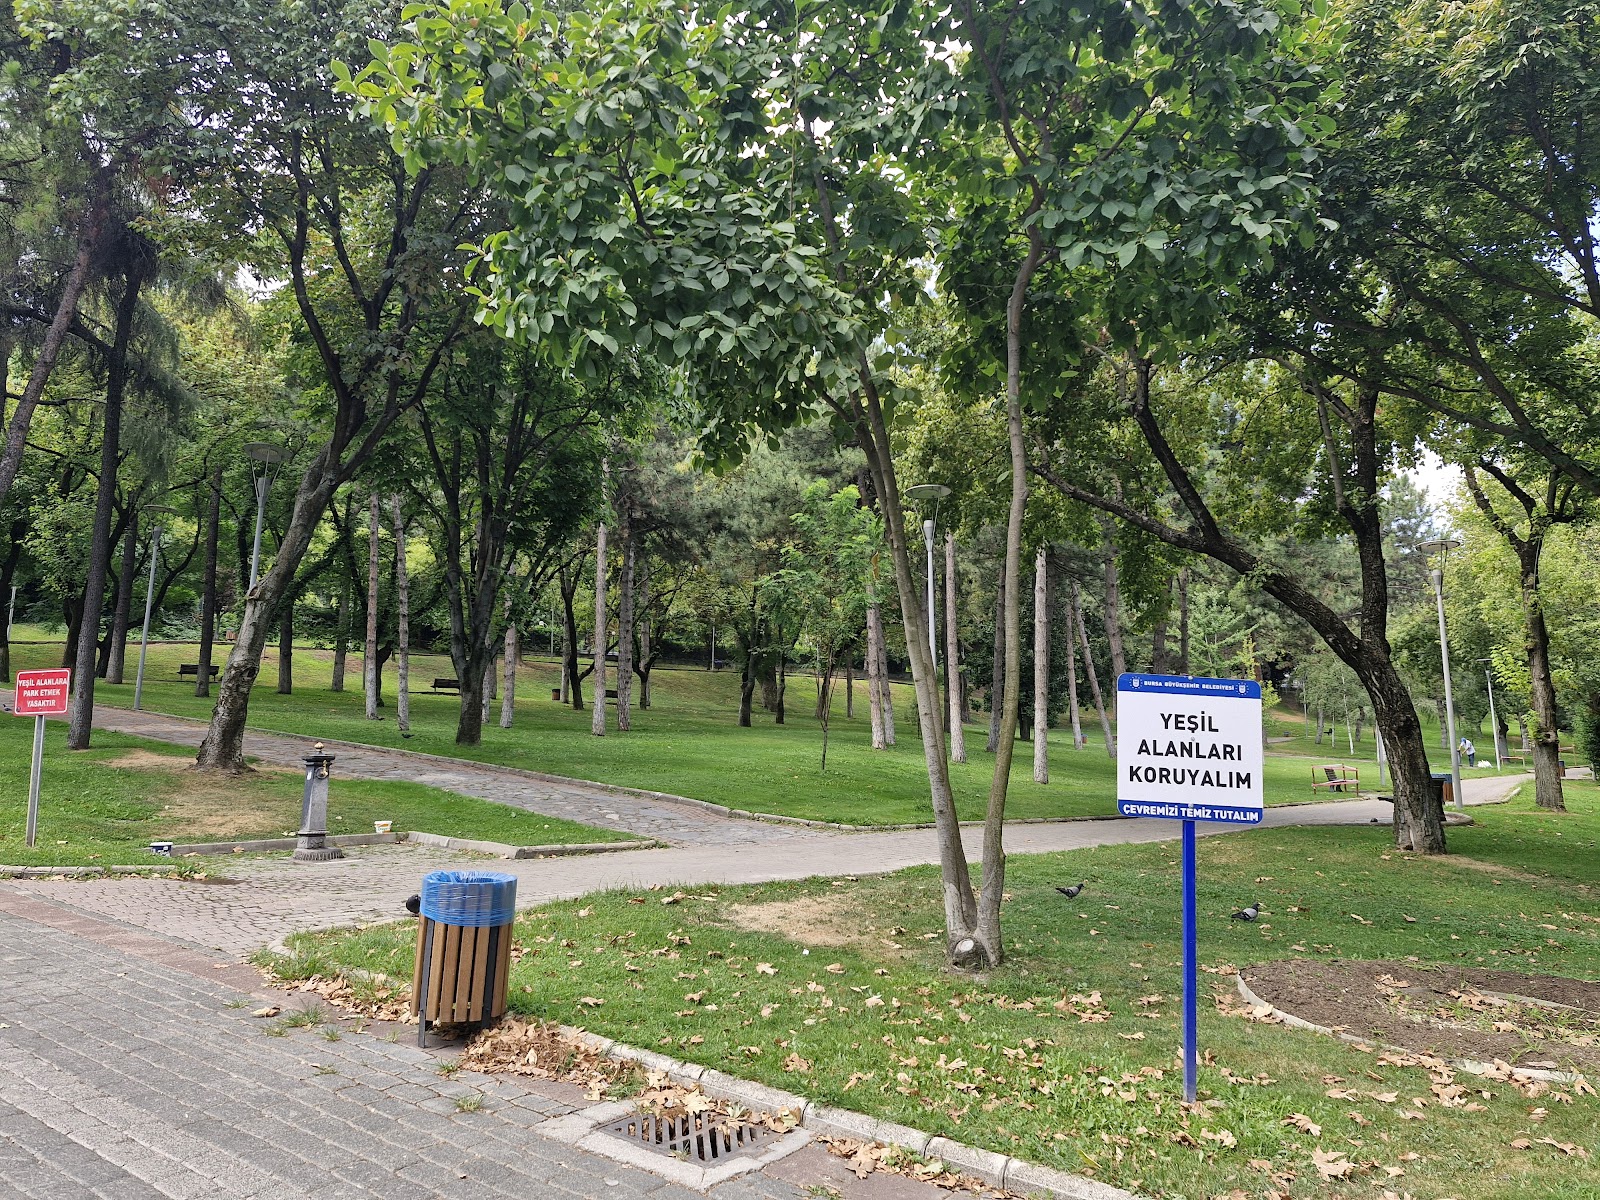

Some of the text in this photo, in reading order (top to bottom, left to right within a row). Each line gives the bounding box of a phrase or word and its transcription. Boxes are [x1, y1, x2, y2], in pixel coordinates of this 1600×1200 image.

[18, 678, 67, 688] YEŞİL ALANLARA
[1164, 680, 1200, 689] BÜYÜKŞEHİR
[1202, 683, 1235, 691] BELEDİYESİ
[23, 689, 39, 697] PARK
[1160, 711, 1219, 733] YEŞİL
[1137, 739, 1242, 761] ALANLARI
[1129, 765, 1251, 789] KORUYALIM
[1123, 804, 1259, 821] ÇEVREMİZİ TEMİZ TUTALIM
